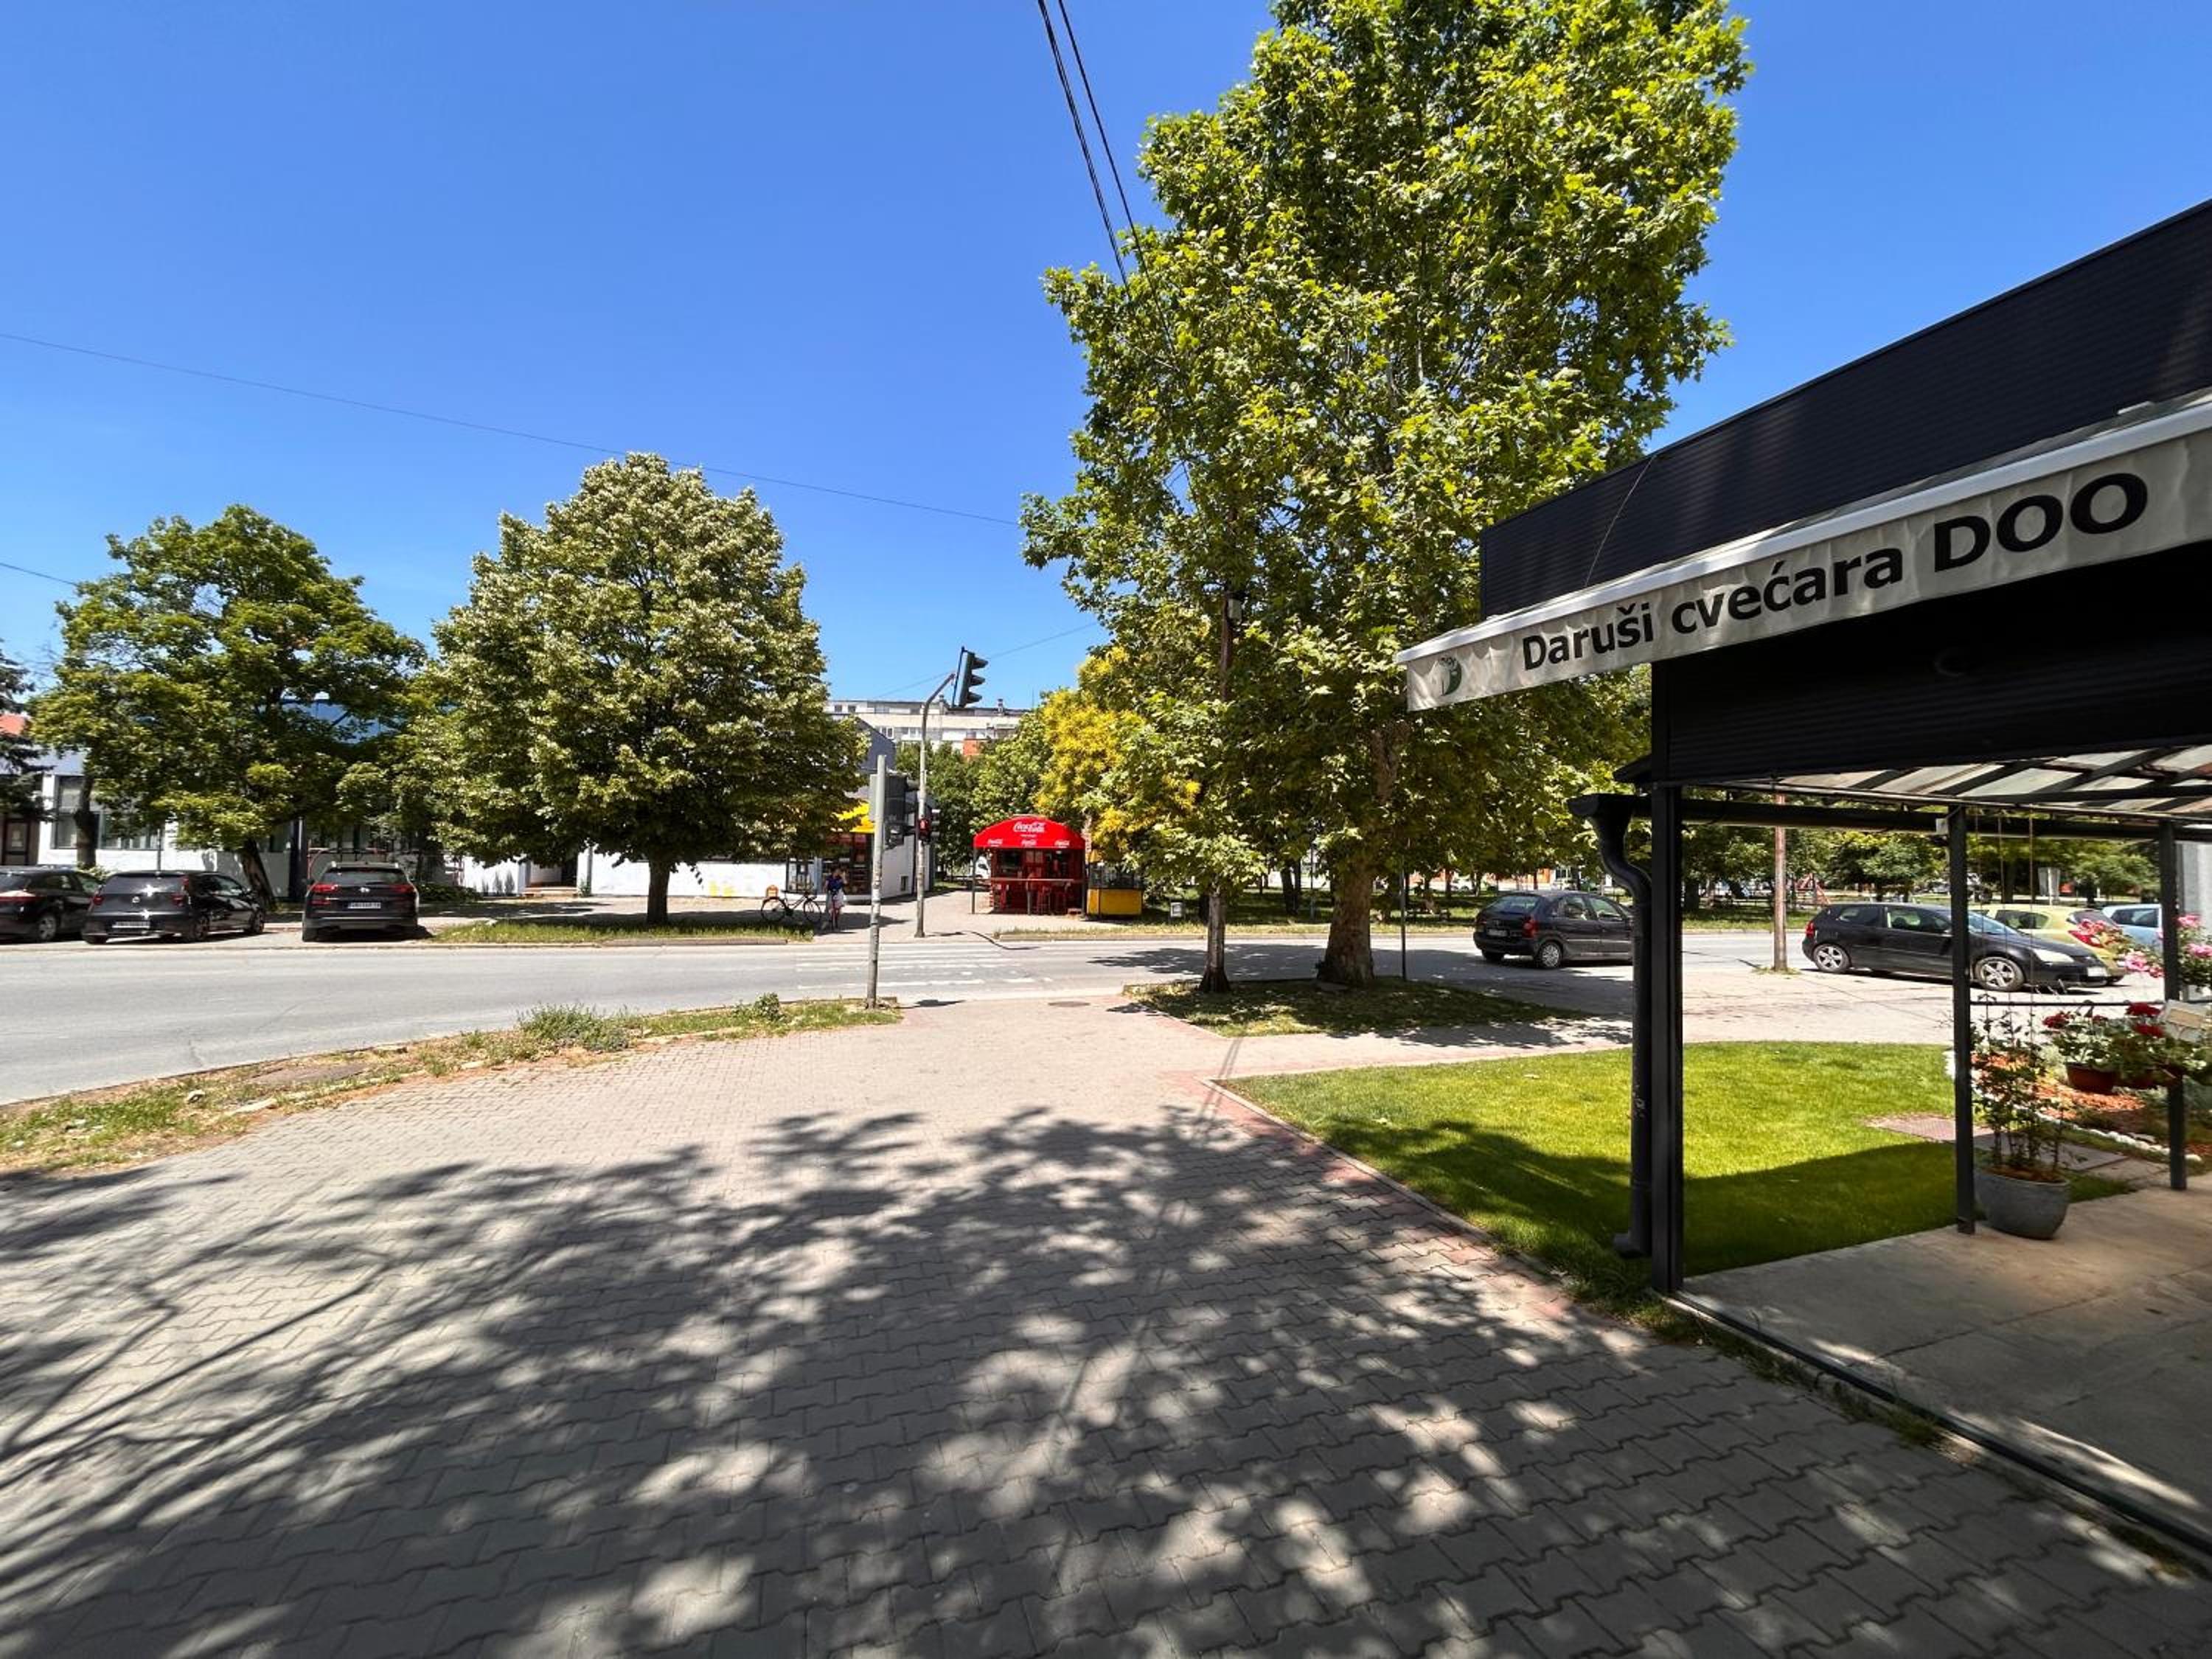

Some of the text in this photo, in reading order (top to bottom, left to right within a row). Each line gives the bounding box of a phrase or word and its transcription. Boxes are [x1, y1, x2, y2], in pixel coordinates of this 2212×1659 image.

[1523, 472, 2149, 671] Daruši cvećara DOO
